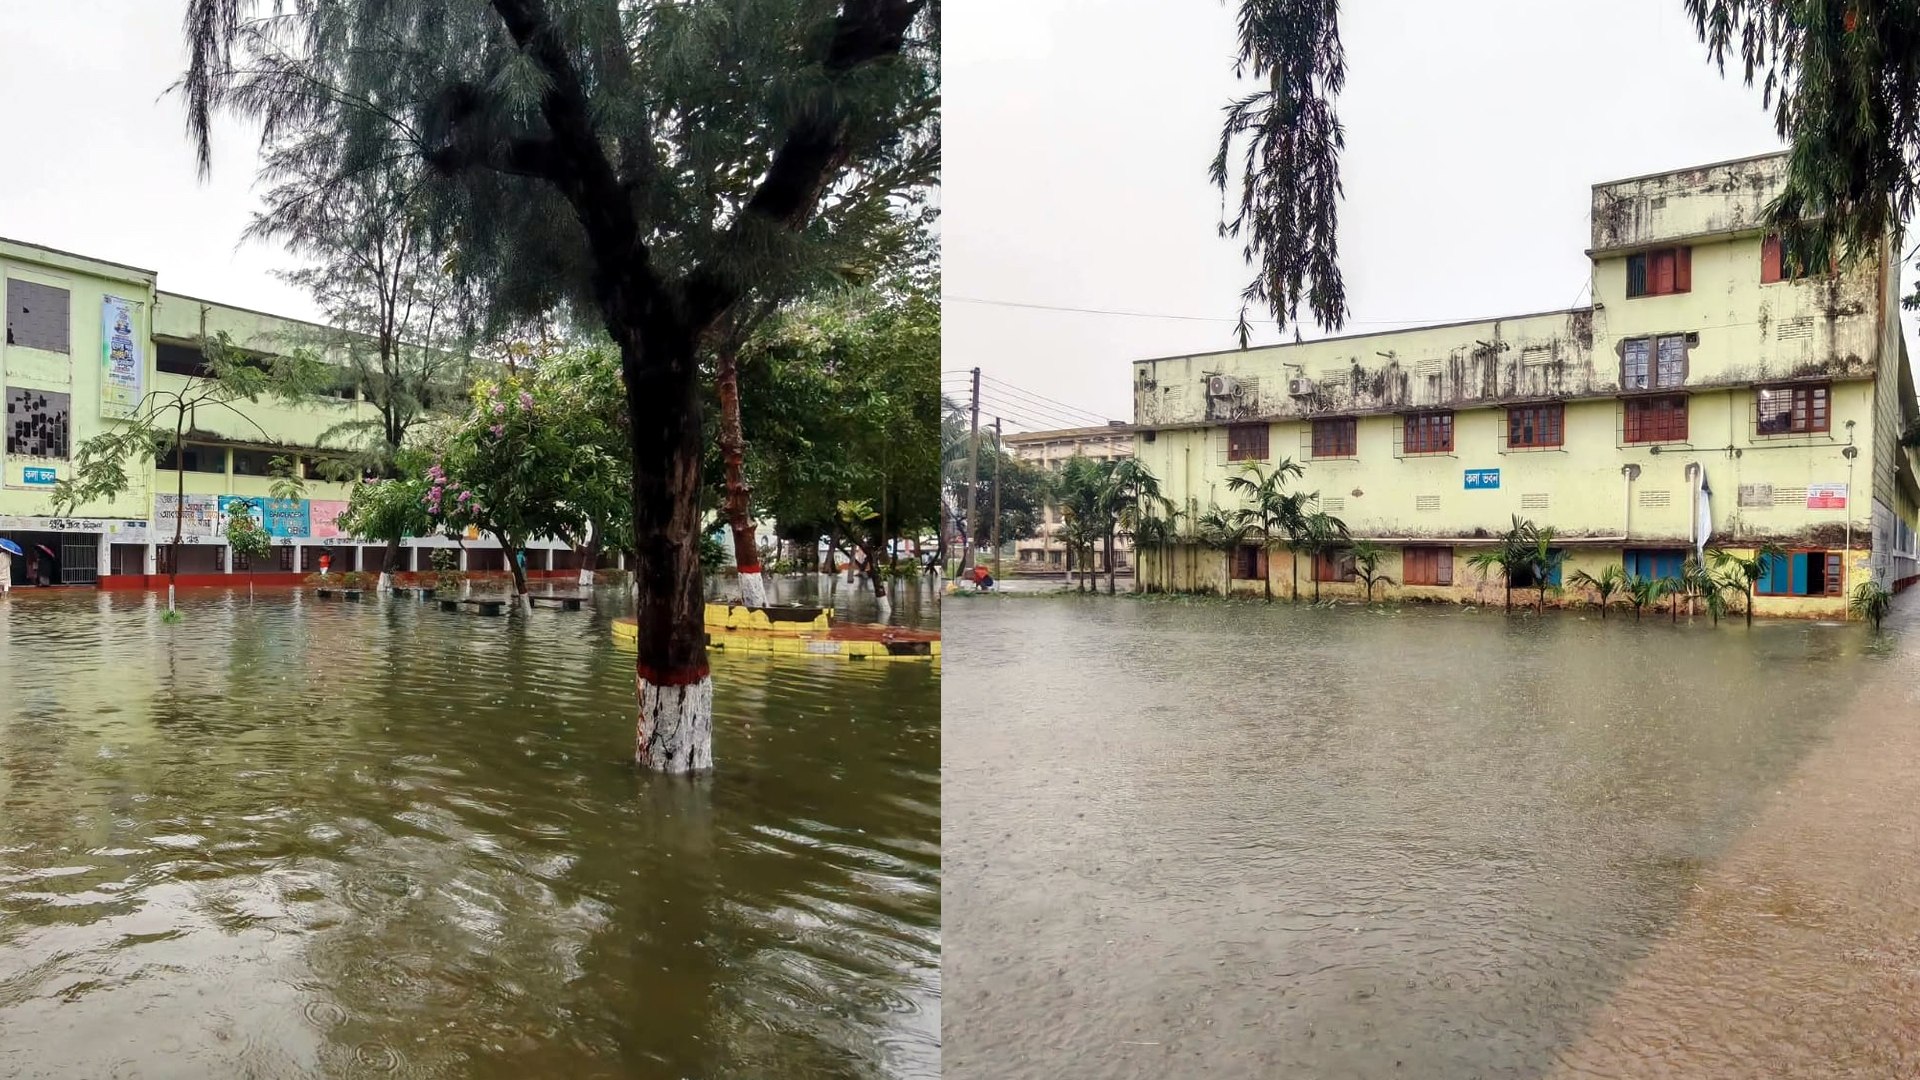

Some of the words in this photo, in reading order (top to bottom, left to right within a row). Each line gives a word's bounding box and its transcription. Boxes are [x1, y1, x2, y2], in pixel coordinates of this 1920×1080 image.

[25, 470, 38, 481] কলা
[40, 471, 55, 480] ভবন
[1466, 473, 1480, 486] কলা
[1482, 473, 1498, 483] ভবন
